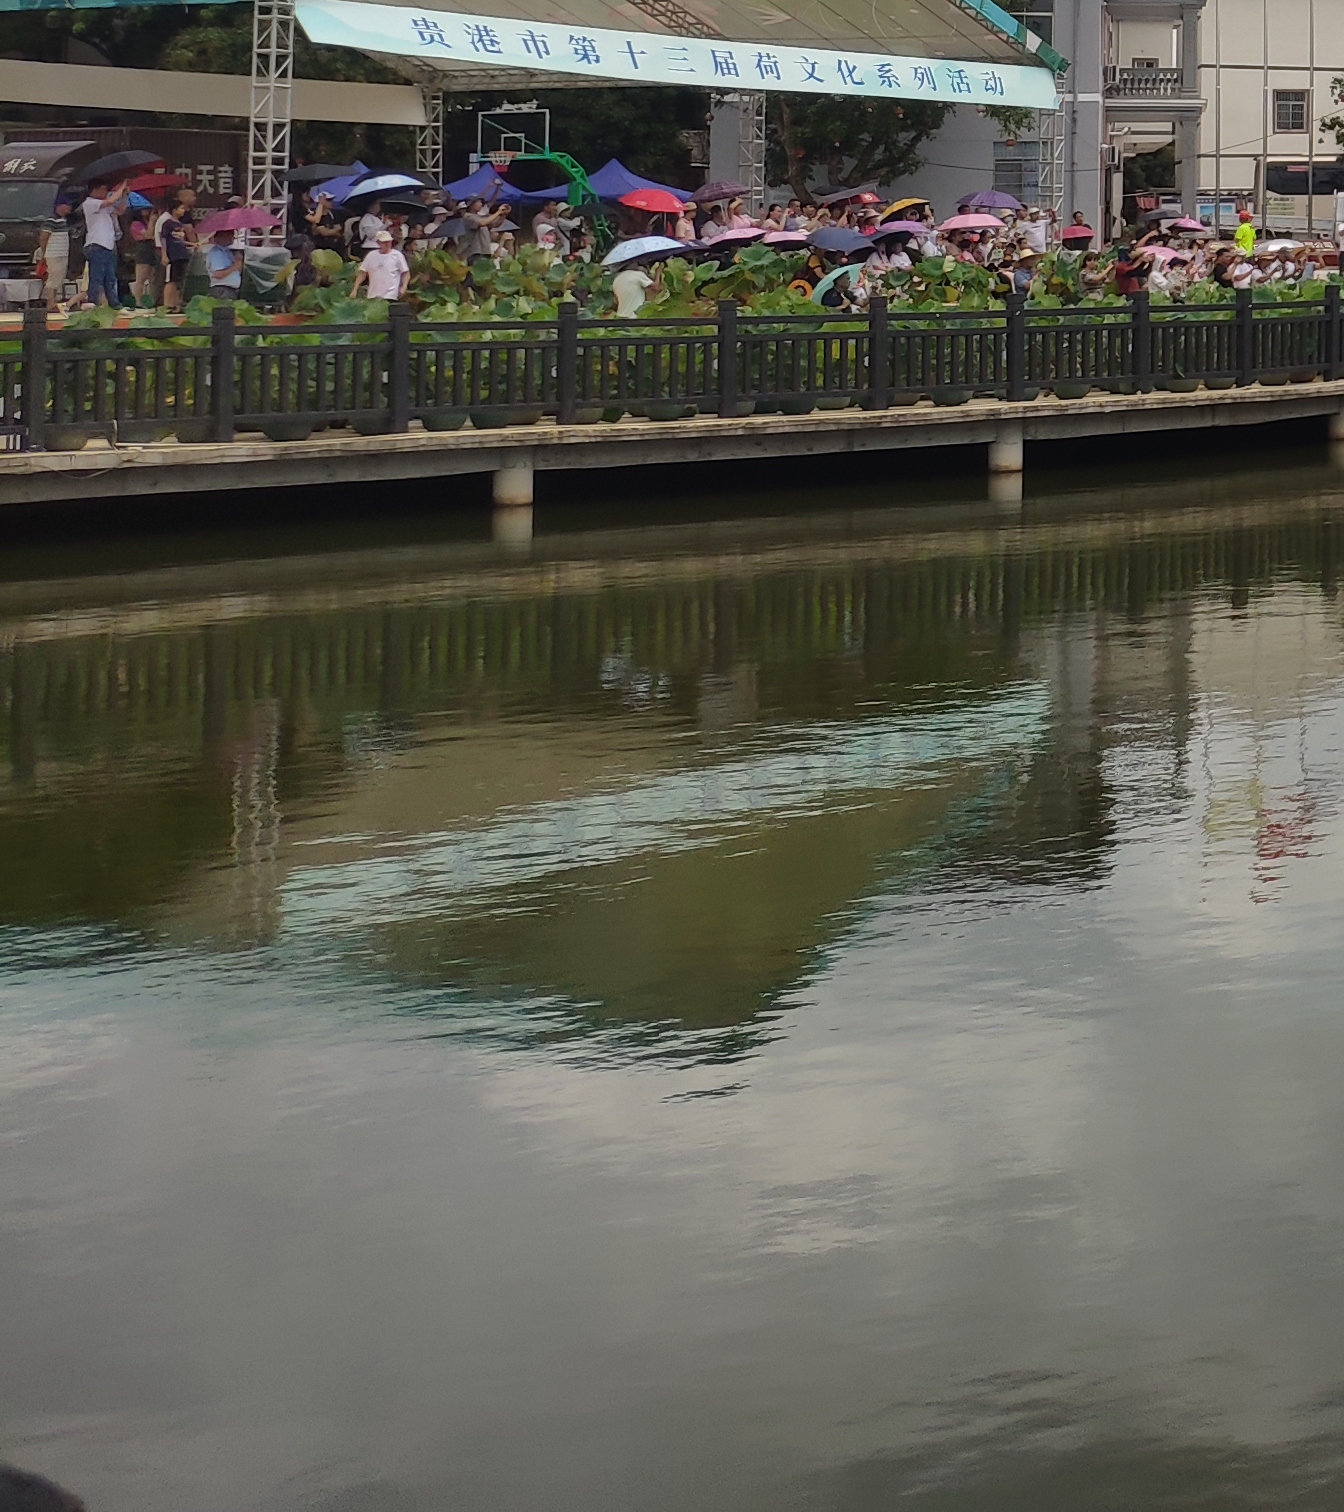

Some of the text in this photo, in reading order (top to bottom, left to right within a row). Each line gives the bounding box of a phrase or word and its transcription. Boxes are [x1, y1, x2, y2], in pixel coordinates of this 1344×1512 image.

[409, 16, 1005, 96] 贵港市第十三届荷文化系列活动
